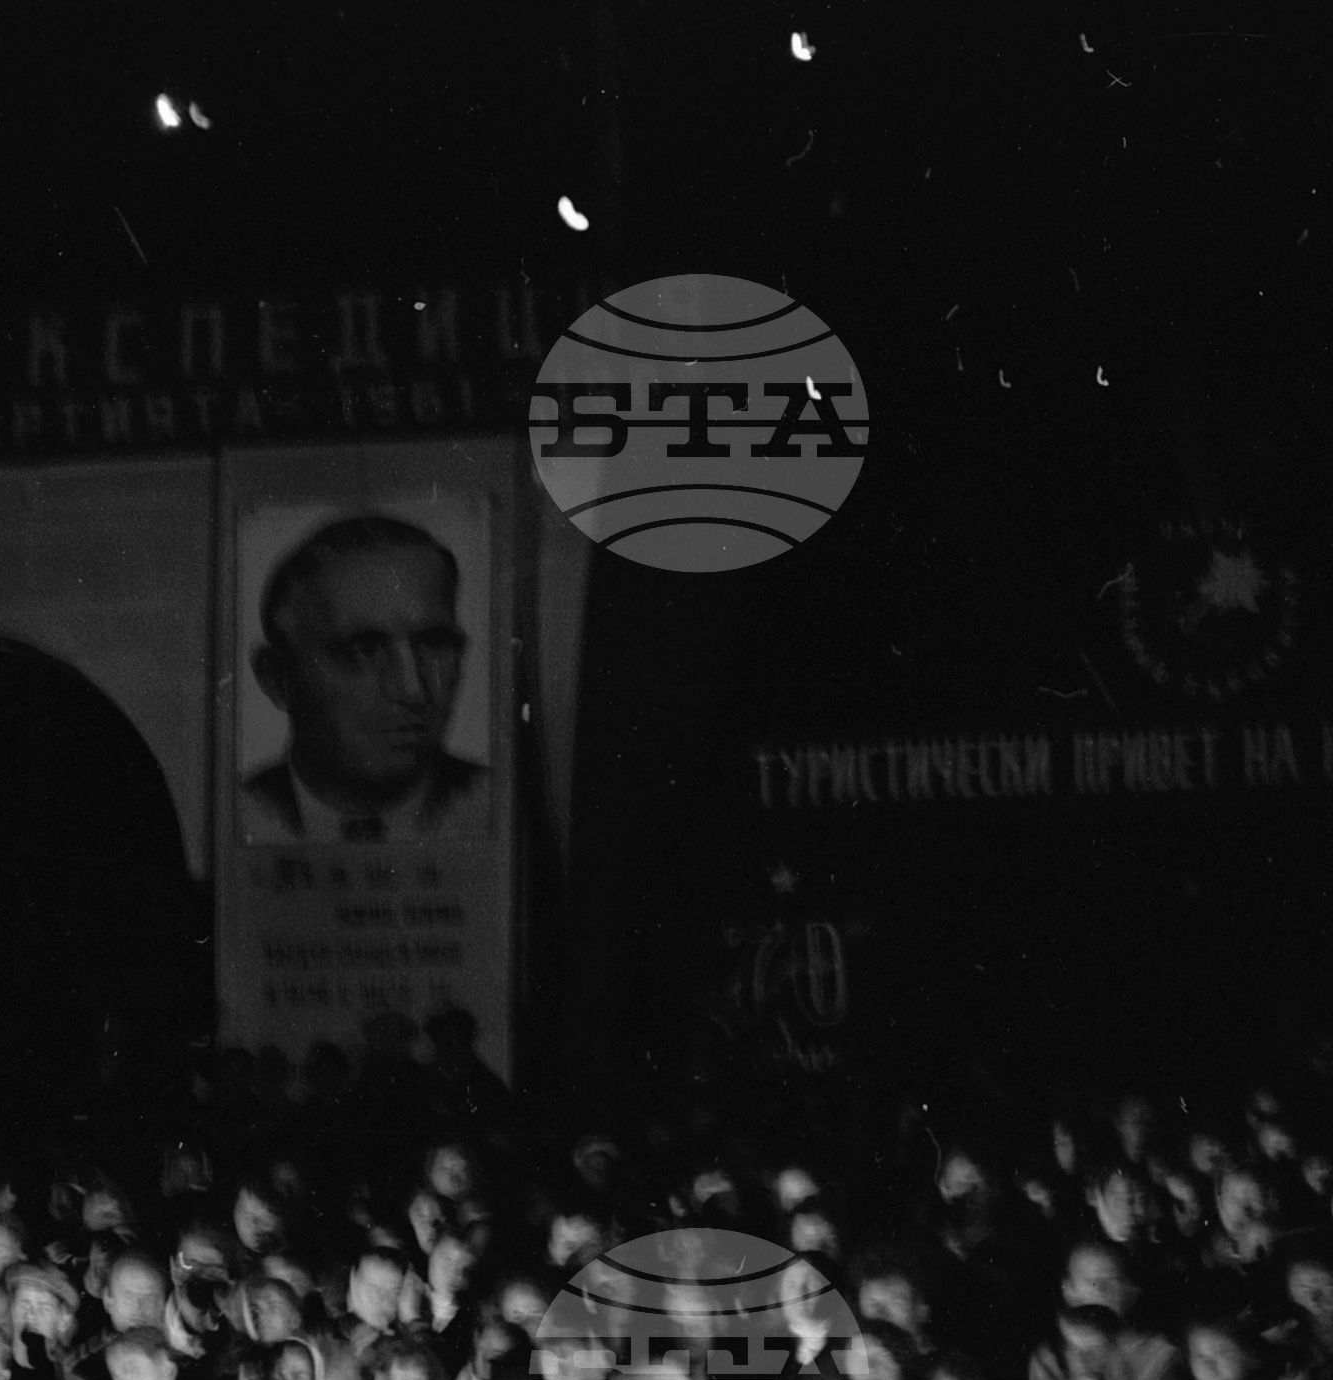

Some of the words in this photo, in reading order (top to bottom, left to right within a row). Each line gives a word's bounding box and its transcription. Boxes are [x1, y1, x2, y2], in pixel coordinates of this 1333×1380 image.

[753, 733, 1052, 807] ТУРИСТИЧЕСКИ
[1071, 726, 1222, 794] ПРИВЕТ
[1242, 721, 1301, 786] НА
